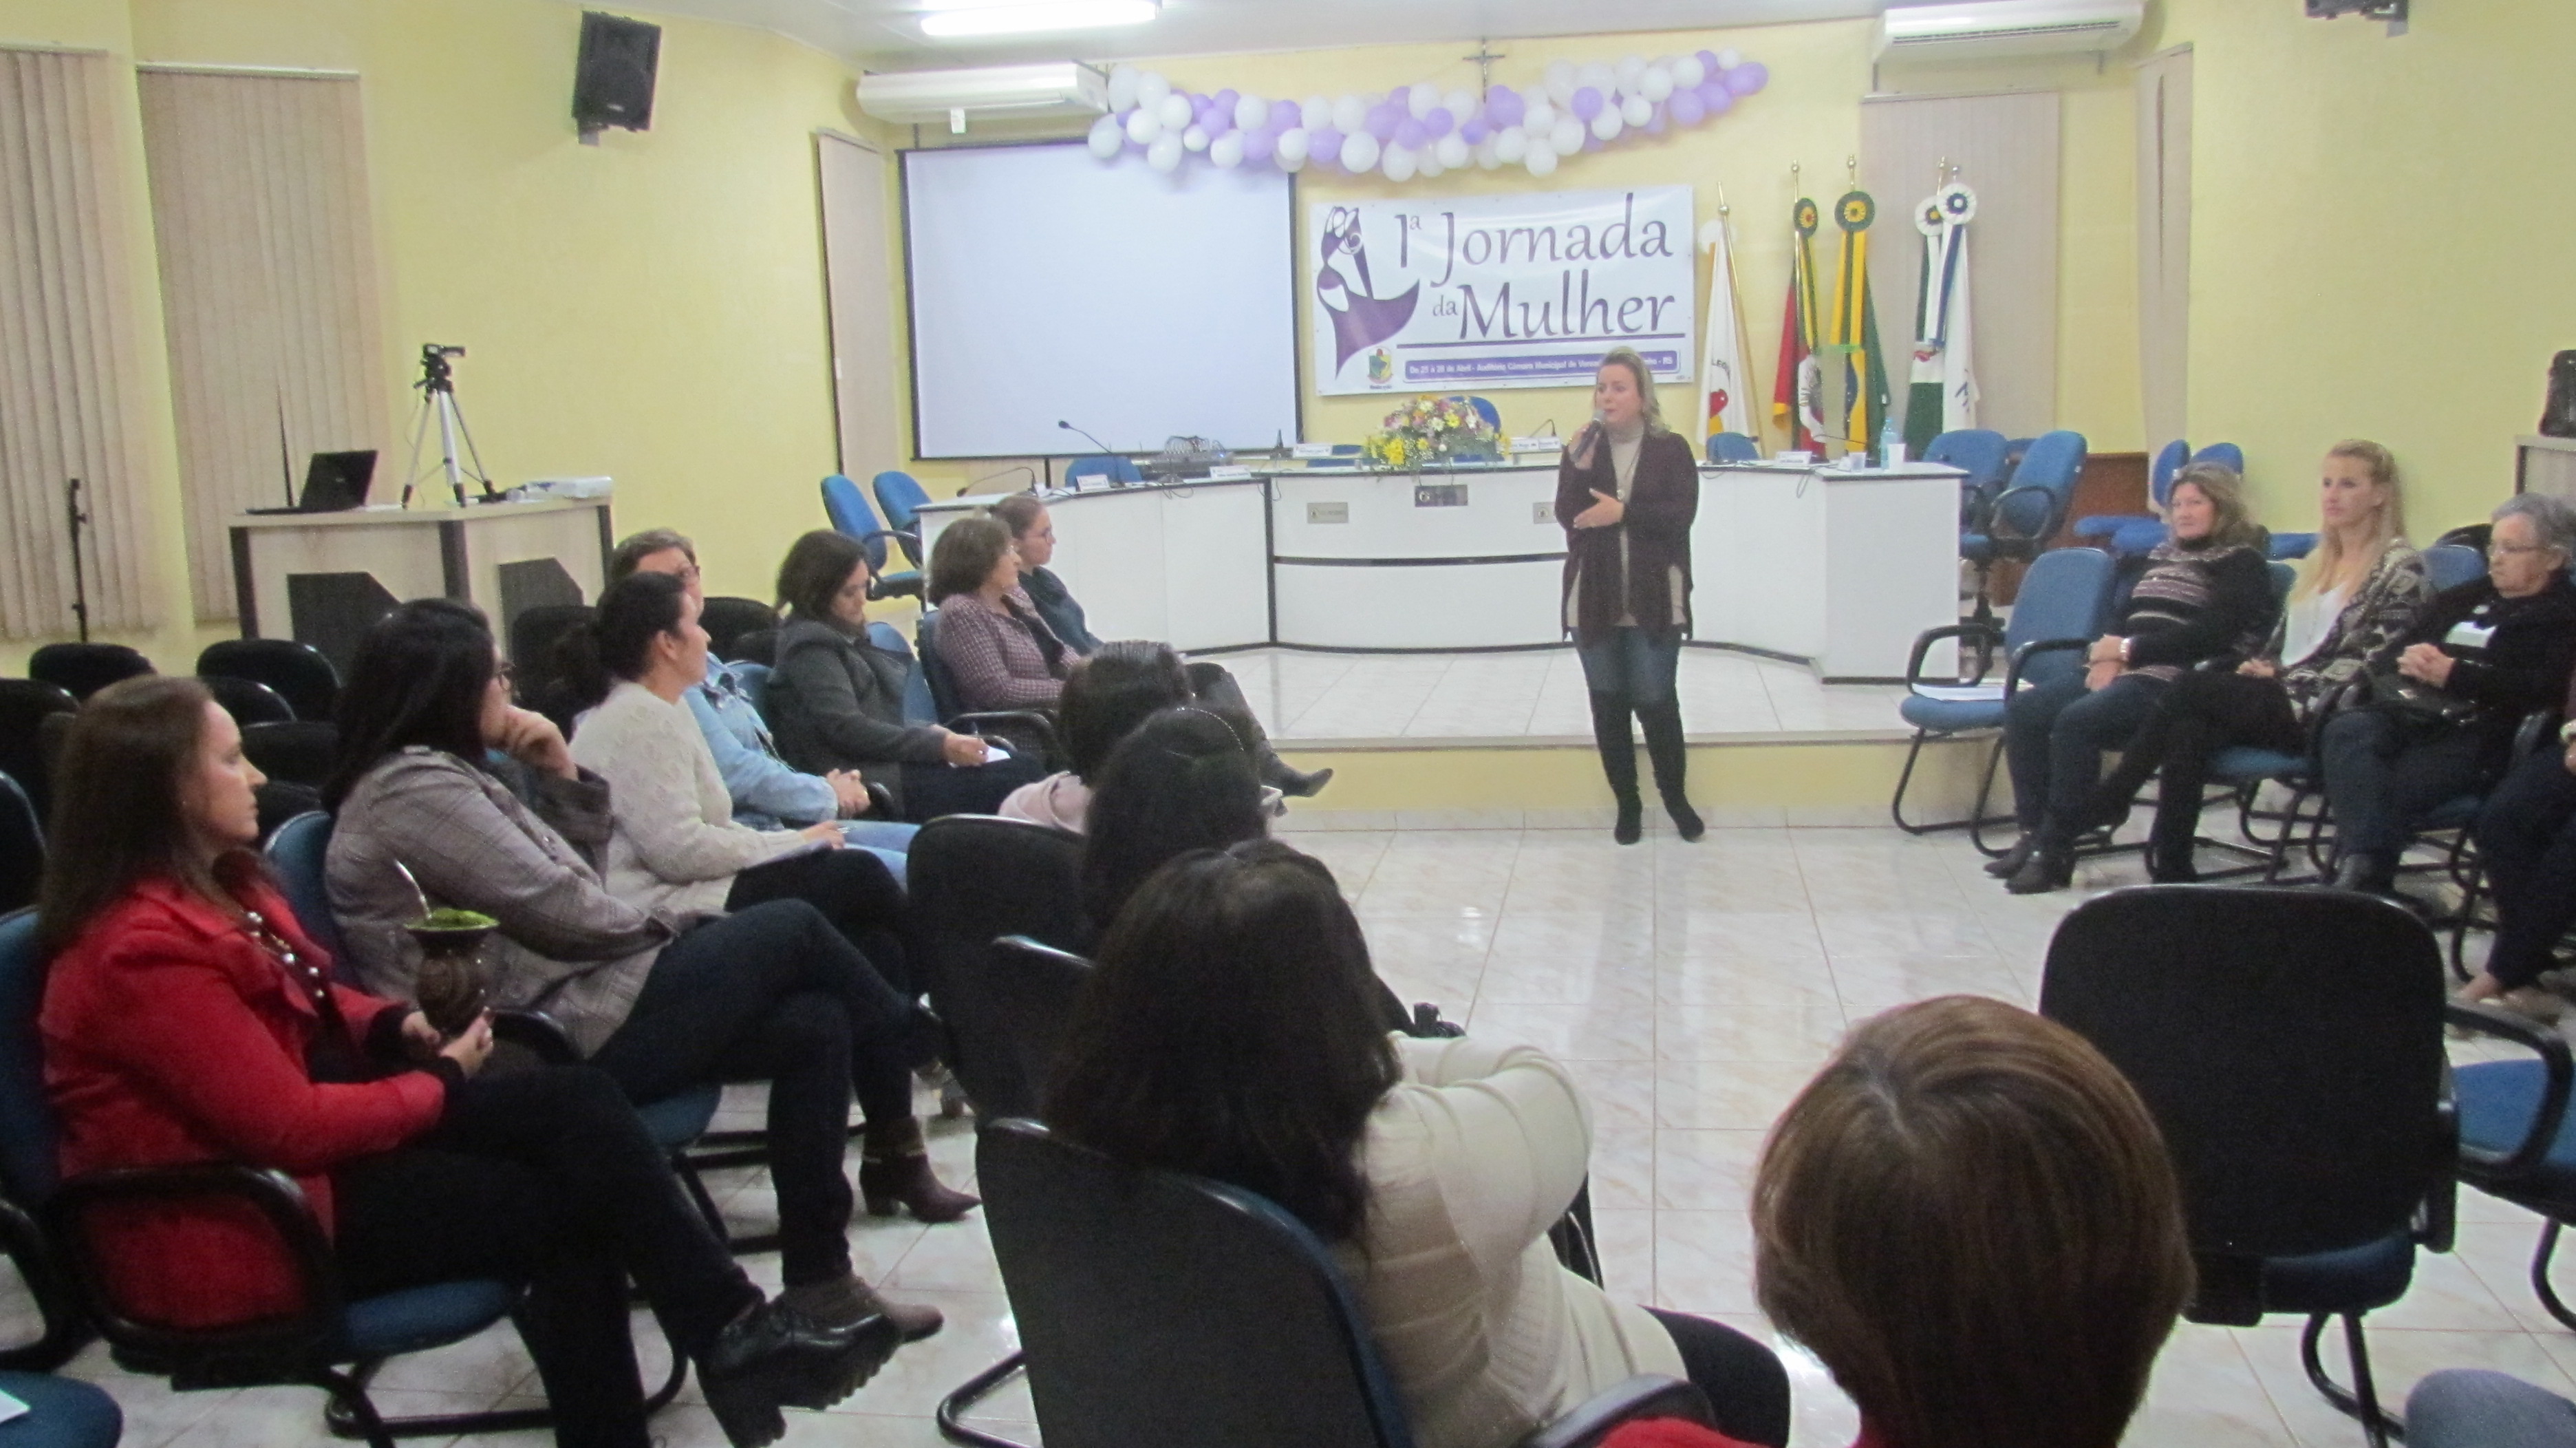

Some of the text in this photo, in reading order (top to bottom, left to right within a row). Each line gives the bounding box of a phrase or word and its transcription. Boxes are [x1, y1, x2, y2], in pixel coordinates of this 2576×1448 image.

[1430, 192, 1674, 288] Jornada
[1432, 269, 1675, 339] da Mulher
[1456, 363, 1472, 372] Abril
[1535, 359, 1567, 370] Municipal
[1662, 356, 1673, 365] RS
